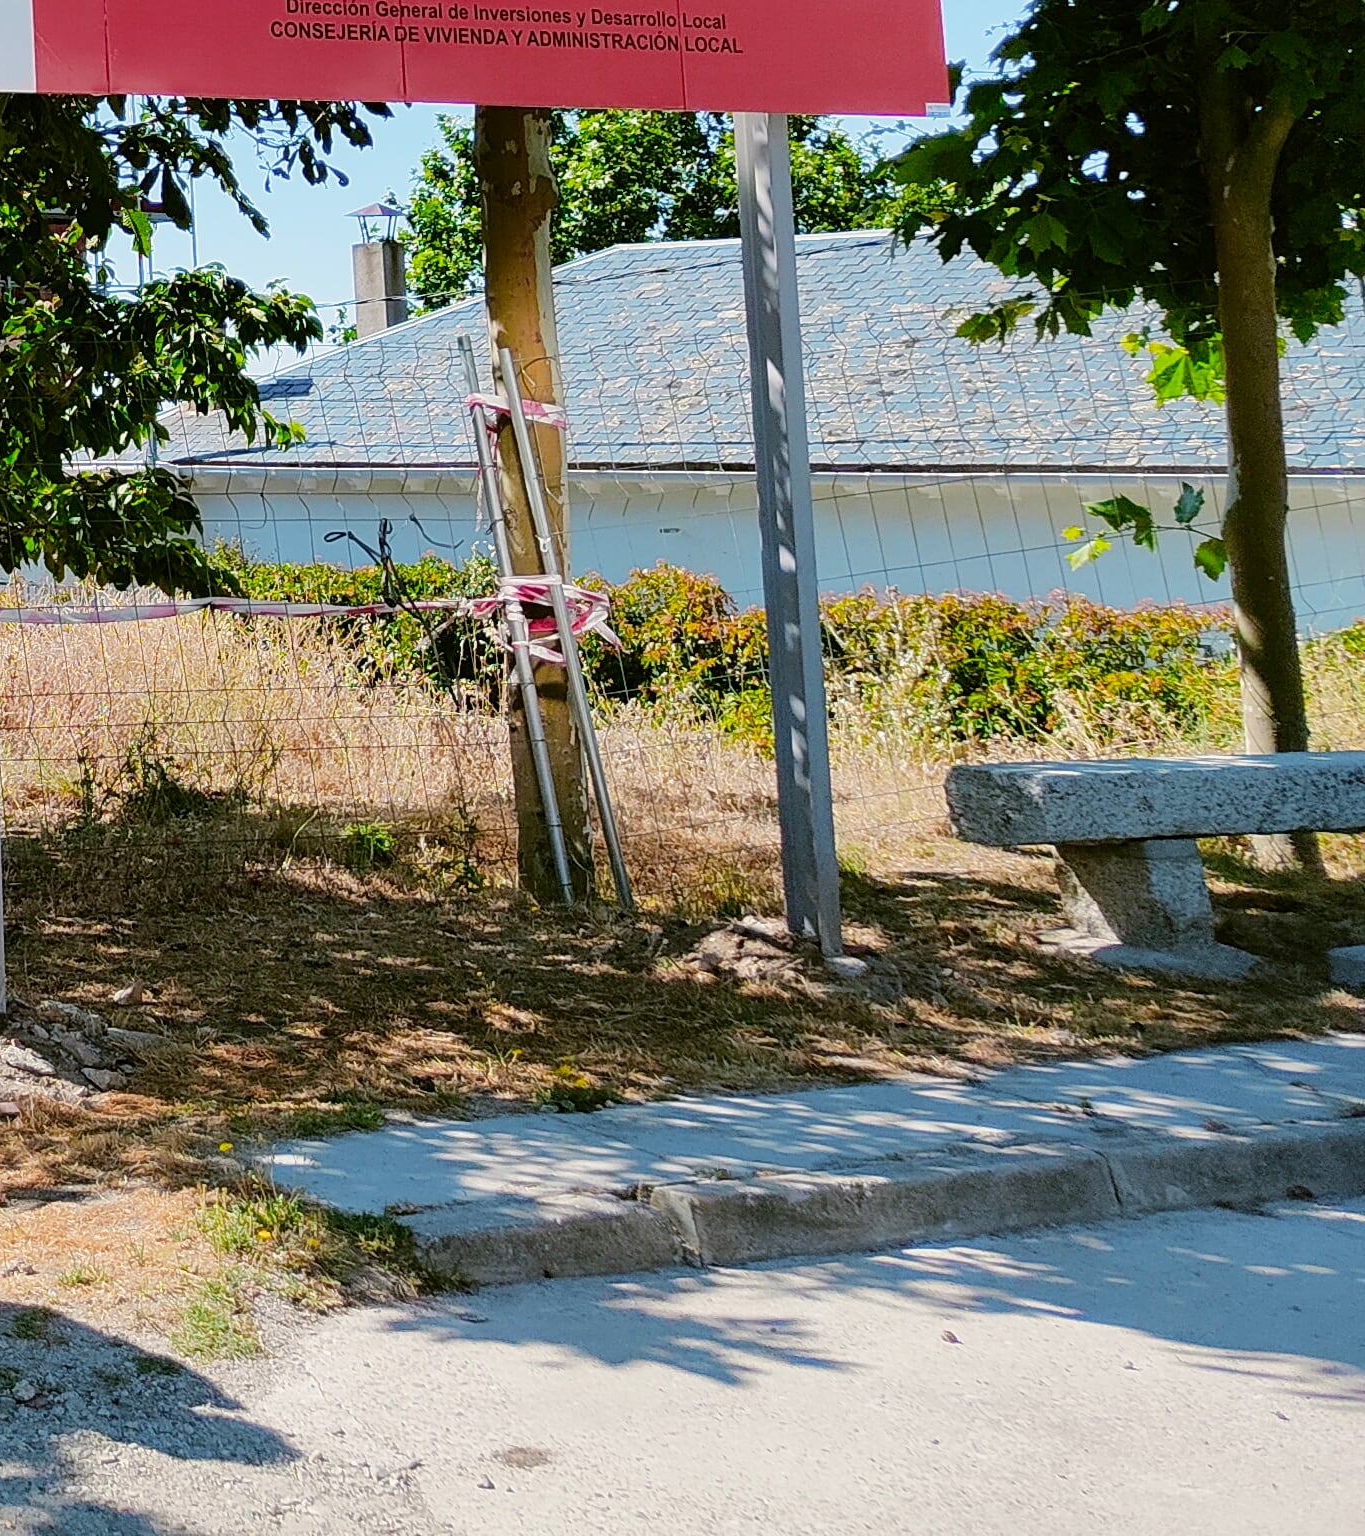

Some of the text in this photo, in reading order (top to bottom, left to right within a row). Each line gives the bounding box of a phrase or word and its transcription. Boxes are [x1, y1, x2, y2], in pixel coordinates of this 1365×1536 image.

[376, 1, 442, 18] General
[449, 3, 468, 19] de
[474, 4, 571, 23] Inversiones
[576, 12, 585, 28] y
[591, 9, 676, 27] Desarrollo
[683, 13, 726, 29] Local
[271, 21, 743, 53] CONSEJERÍA DE VIVIENDA Y ADMINISTRACIÓN LOCAL
